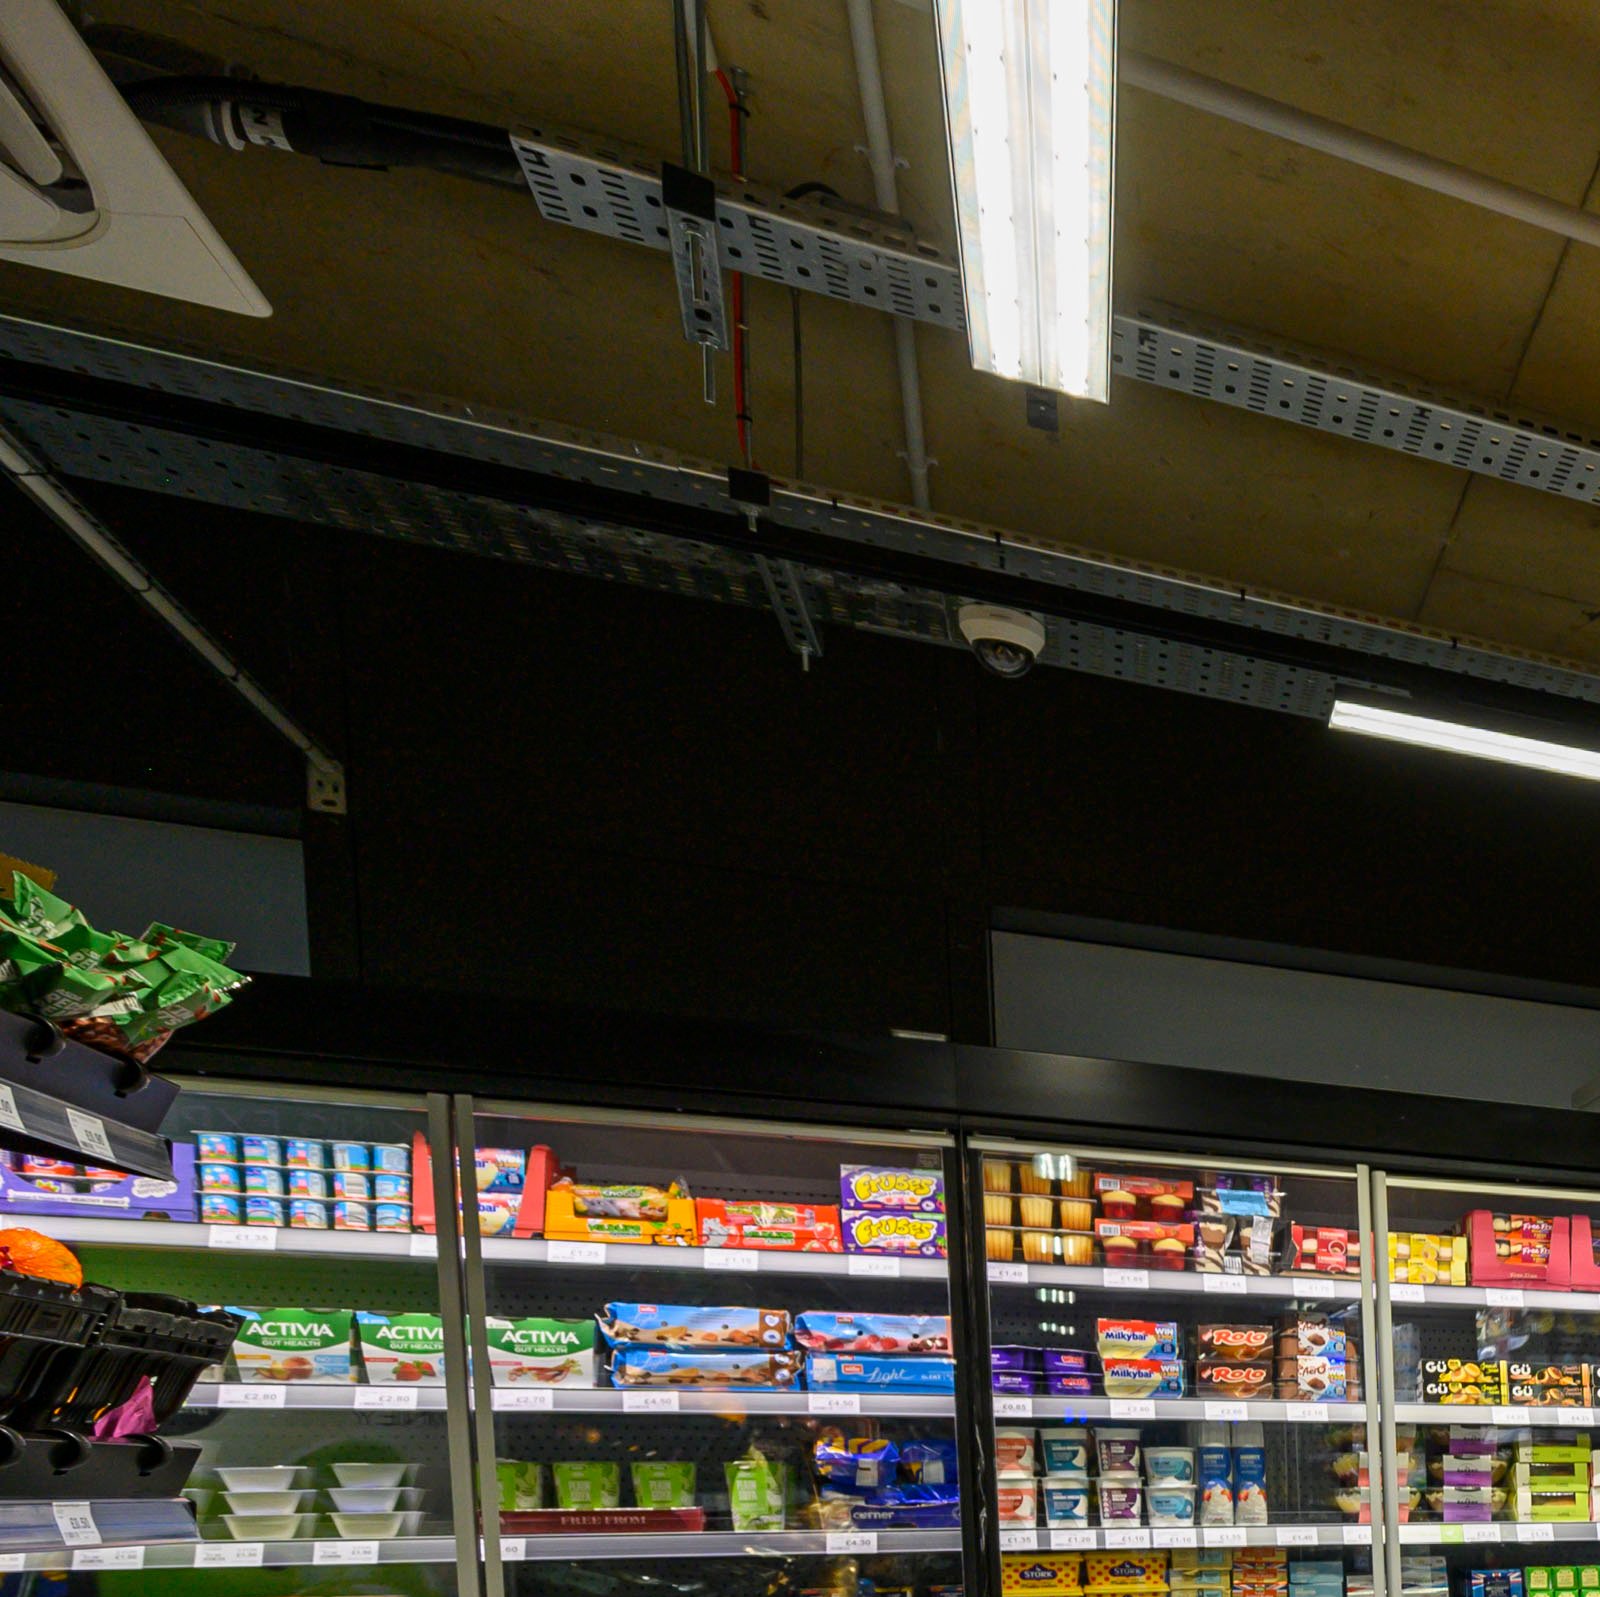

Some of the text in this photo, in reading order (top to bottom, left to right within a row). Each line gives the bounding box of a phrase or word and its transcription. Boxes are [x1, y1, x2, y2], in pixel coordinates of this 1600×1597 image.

[246, 1321, 334, 1338] ACTIVIA
[501, 1329, 579, 1345] ACTIVIA
[1105, 1330, 1148, 1342] Milkybar
[1213, 1329, 1267, 1347] Rolo
[1023, 1568, 1054, 1579] STORK
